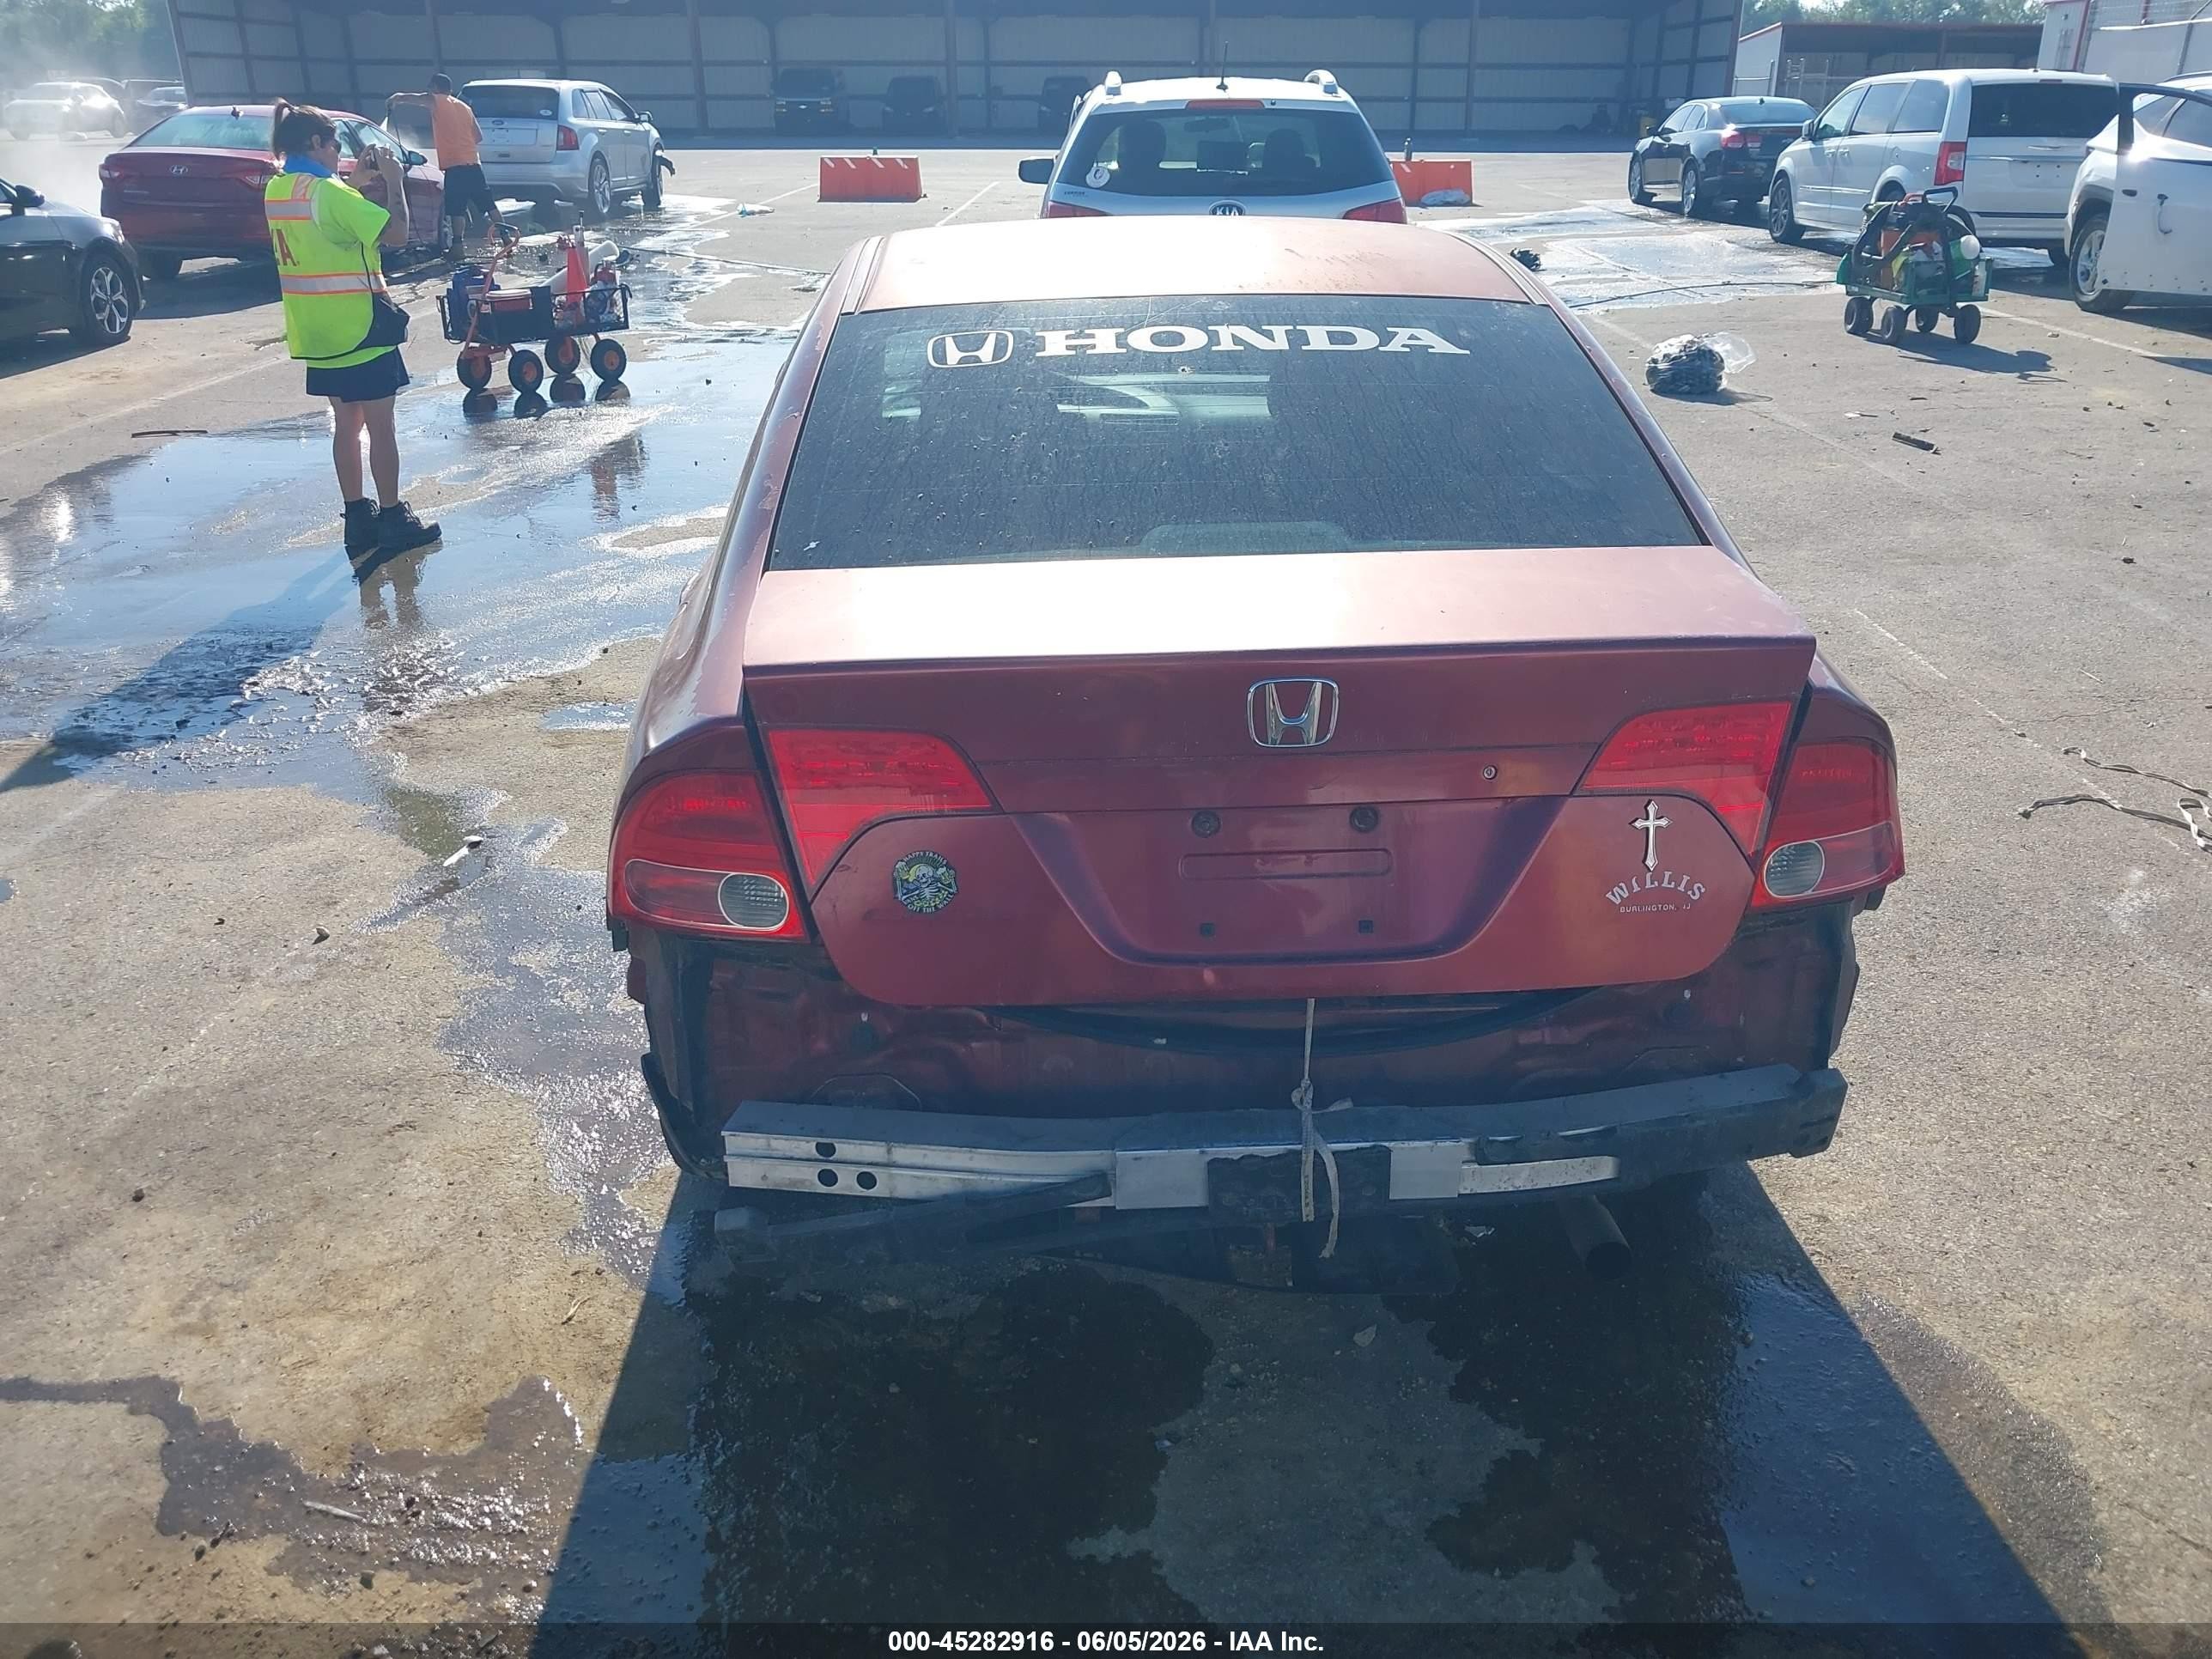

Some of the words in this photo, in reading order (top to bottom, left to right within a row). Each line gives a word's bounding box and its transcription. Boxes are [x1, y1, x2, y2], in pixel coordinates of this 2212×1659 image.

[1216, 206, 1239, 216] KIA
[1035, 325, 1471, 356] HONDA
[902, 851, 923, 862] HAPPY
[925, 851, 947, 865] TRAILS
[1606, 871, 1705, 905] WILLIS
[907, 903, 921, 912] OFF
[938, 894, 954, 908] WALL
[1620, 903, 1677, 913] BURLINGTON,
